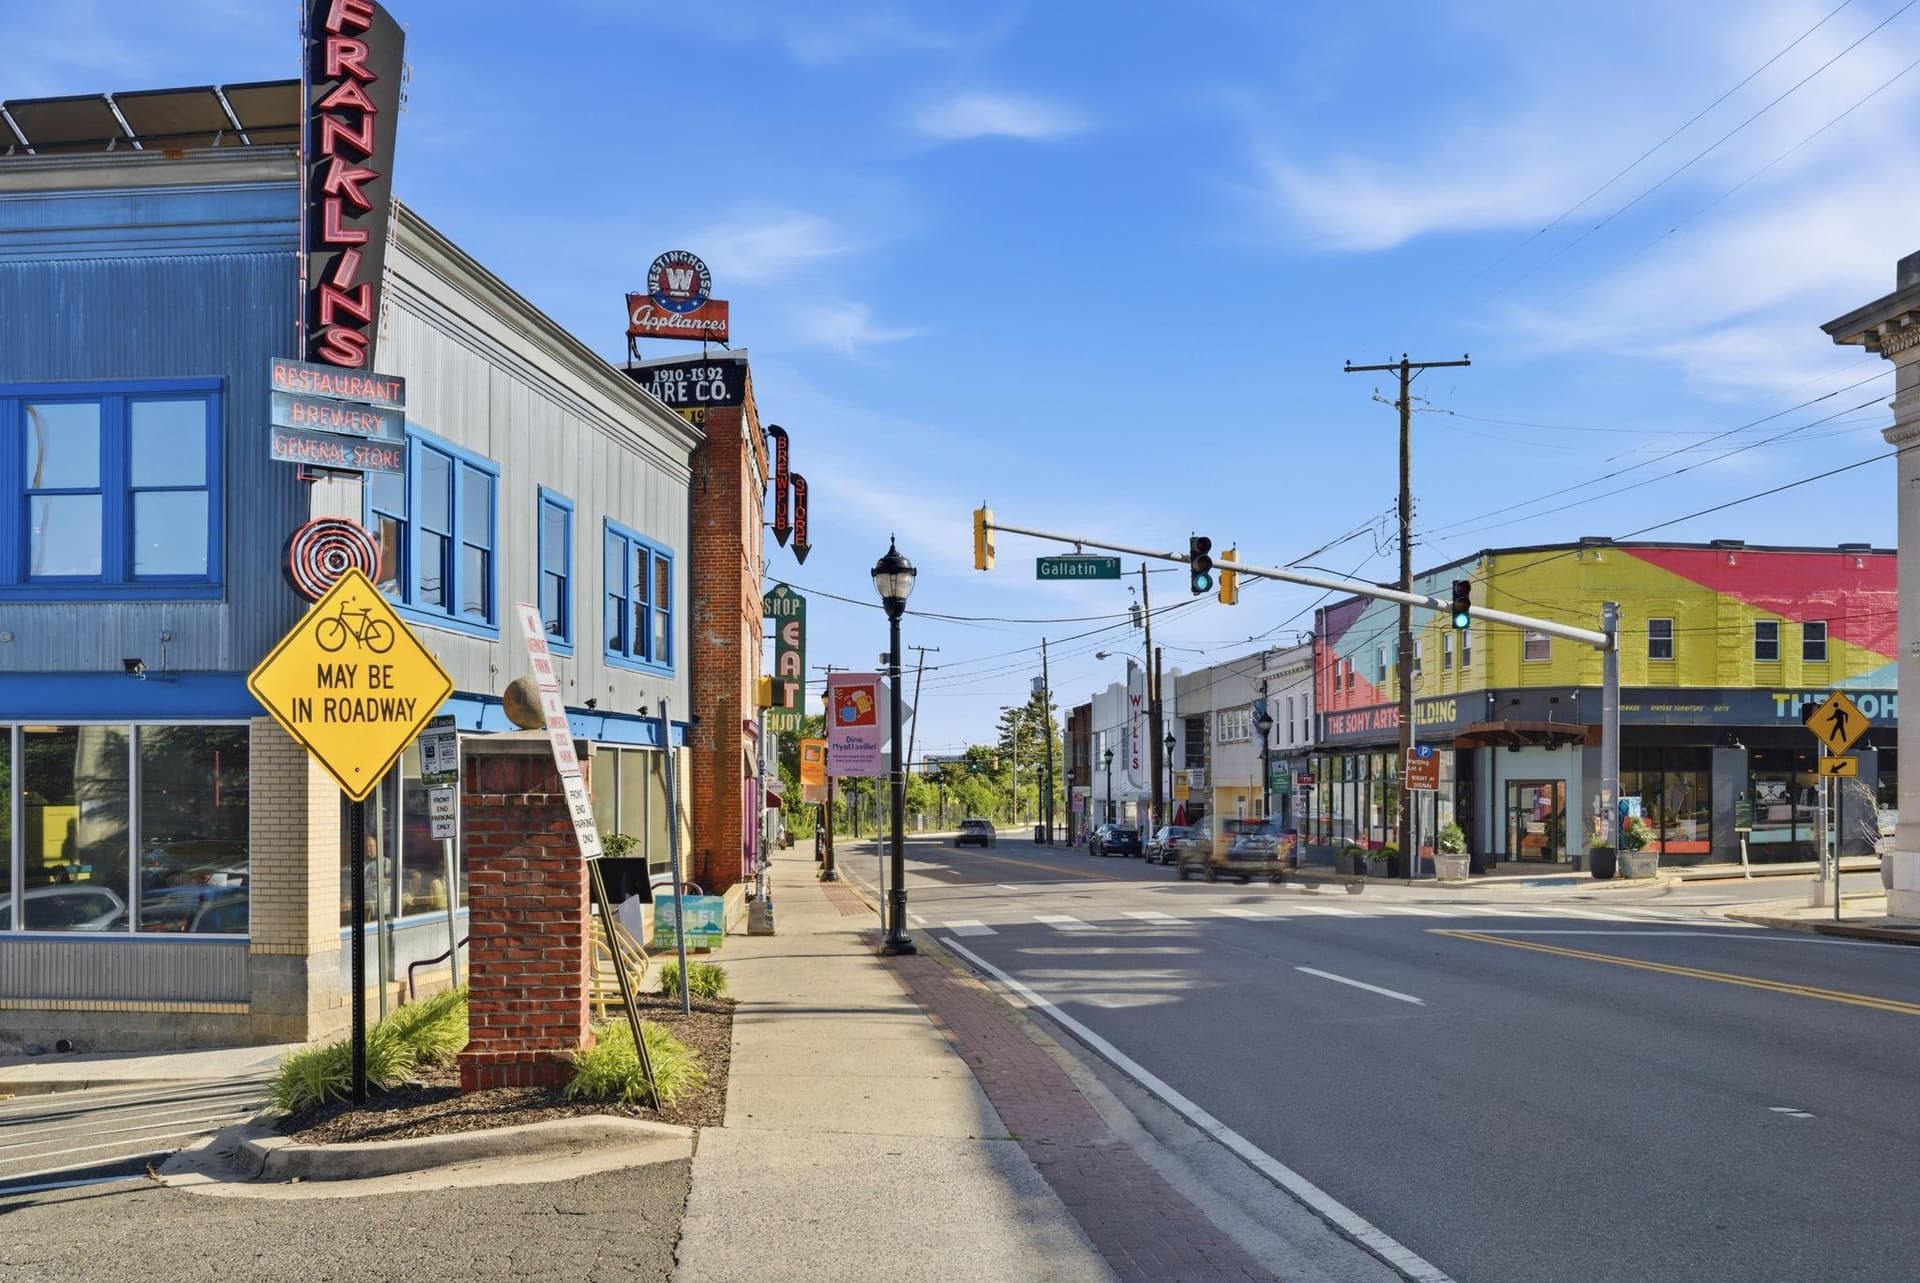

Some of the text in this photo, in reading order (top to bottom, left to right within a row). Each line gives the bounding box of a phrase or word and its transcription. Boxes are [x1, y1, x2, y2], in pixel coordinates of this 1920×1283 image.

[317, 0, 380, 368] FRANKLINS
[647, 251, 711, 297] WESTINGHOUSE
[631, 304, 727, 331] Appliances
[274, 365, 400, 401] RESTAURANT
[695, 381, 732, 401] CO.
[291, 402, 384, 433] BREWERY
[273, 435, 400, 469] GENERAL STORE
[777, 436, 787, 530] BREWPUB
[796, 479, 806, 545] STORE
[1041, 562, 1097, 576] Gallatin
[764, 598, 801, 616] SHOP
[317, 664, 394, 689] MAY BE
[780, 621, 800, 709] EAT
[292, 698, 417, 722] IN ROADWAY
[1328, 699, 1456, 734] THE SOHY ARTS ILDING
[1129, 694, 1141, 770] WILLS
